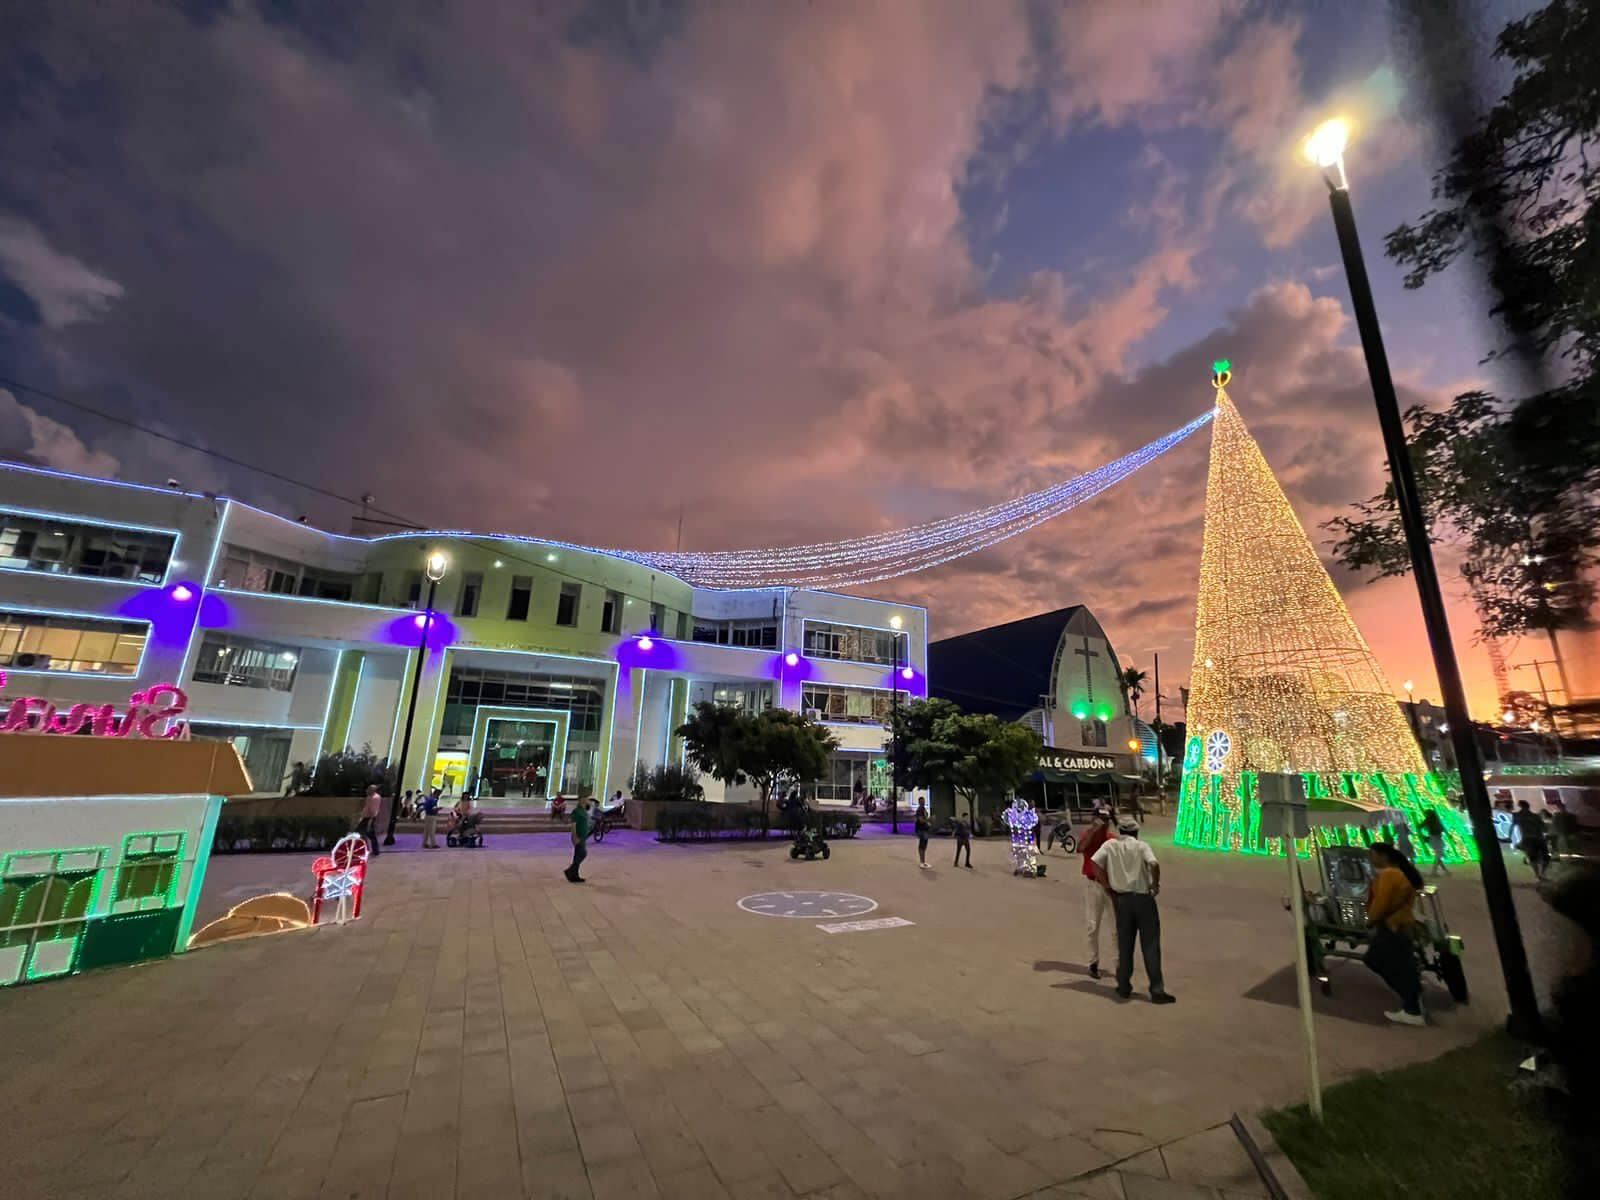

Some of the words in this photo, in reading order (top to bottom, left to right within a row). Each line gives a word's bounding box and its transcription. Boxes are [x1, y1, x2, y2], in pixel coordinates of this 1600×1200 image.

[1034, 755, 1053, 768] AL
[1054, 756, 1062, 768] &
[1063, 755, 1106, 769] CARBÓN
